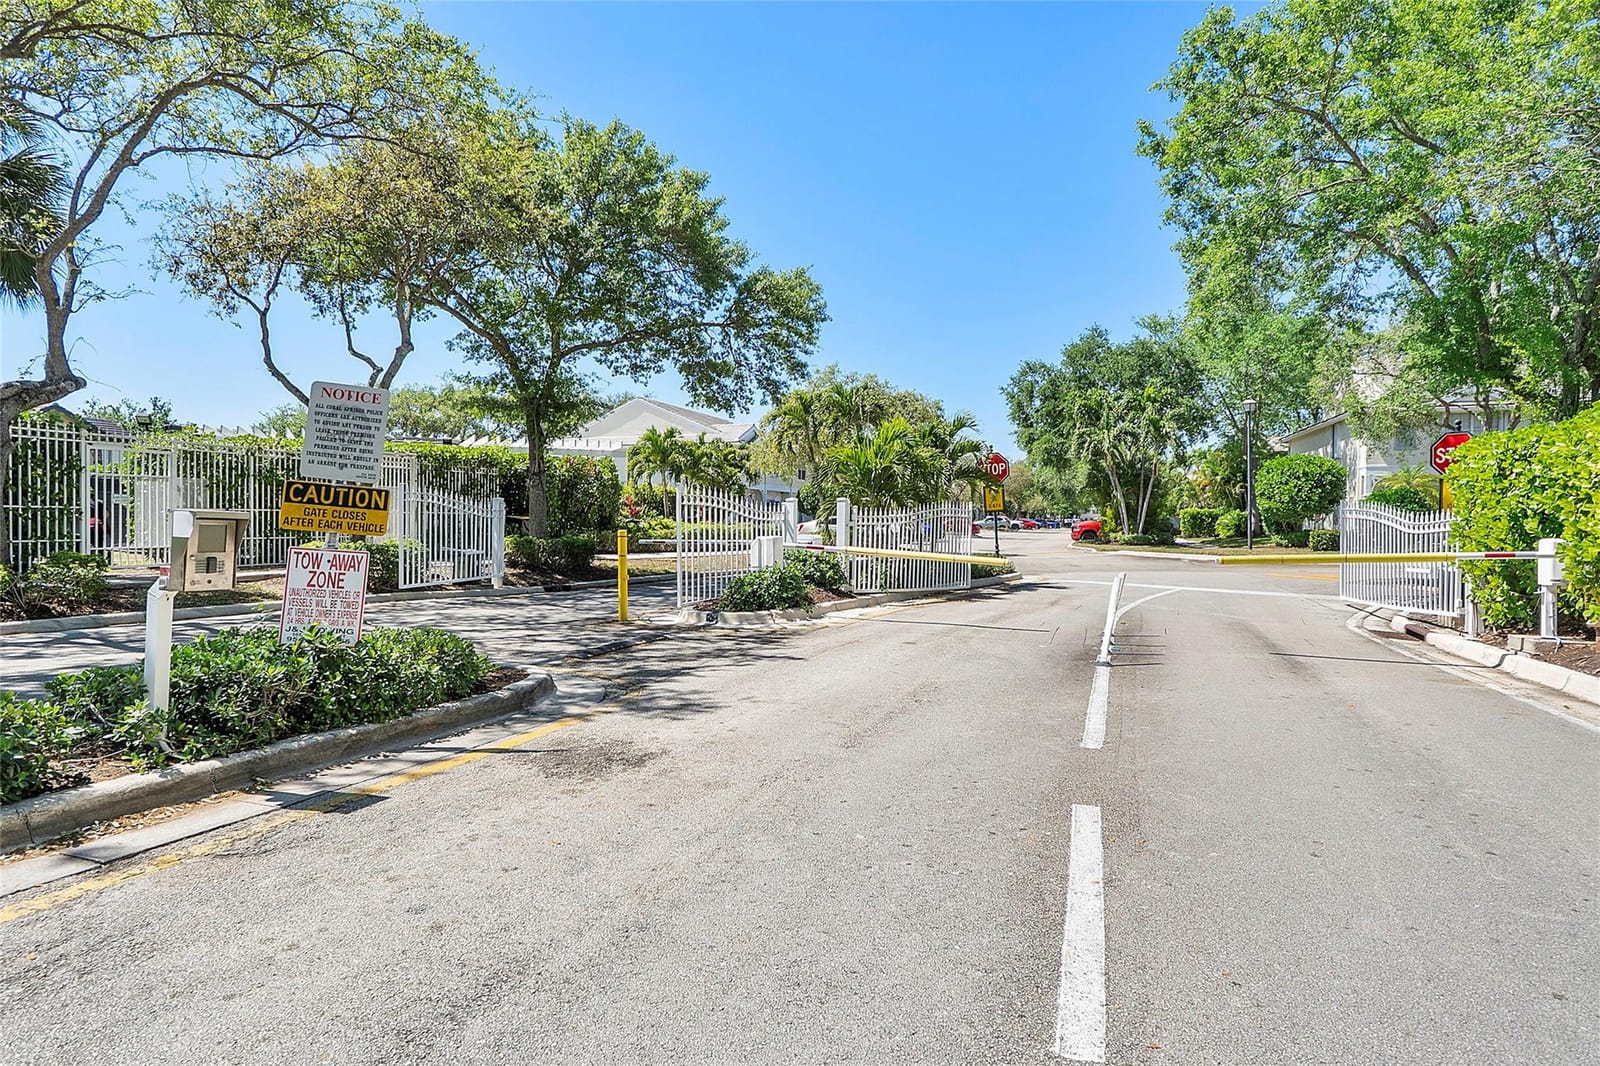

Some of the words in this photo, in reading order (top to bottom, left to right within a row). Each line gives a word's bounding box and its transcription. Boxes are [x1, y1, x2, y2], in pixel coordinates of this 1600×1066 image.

[321, 387, 381, 404] NOTICE
[352, 414, 382, 423] AUTHORIZED
[353, 423, 372, 431] PERSON
[314, 443, 340, 451] PREMISES
[306, 450, 337, 459] INSTRUCTED
[316, 460, 337, 468] ARREST
[987, 463, 1006, 474] TOP
[289, 483, 386, 509] CAUTION
[303, 507, 328, 518] GATE
[332, 510, 366, 520] CLOSES
[282, 516, 314, 528] AFTER
[318, 520, 342, 530] EACH
[347, 522, 384, 533] VEHICLE
[294, 552, 324, 570] TOW
[329, 554, 364, 572] AWAY
[306, 570, 346, 589] ZONE
[289, 588, 327, 598] UNAUTHORIZED
[328, 590, 352, 600] VEHICLES
[353, 592, 360, 600] OR
[288, 598, 312, 608] VESSELS
[316, 599, 328, 608] WILL
[330, 600, 337, 608] BE
[340, 600, 360, 610] TOWED
[288, 608, 294, 616] AT
[294, 608, 314, 618] VEHICLE
[337, 610, 358, 620] EXPENSE
